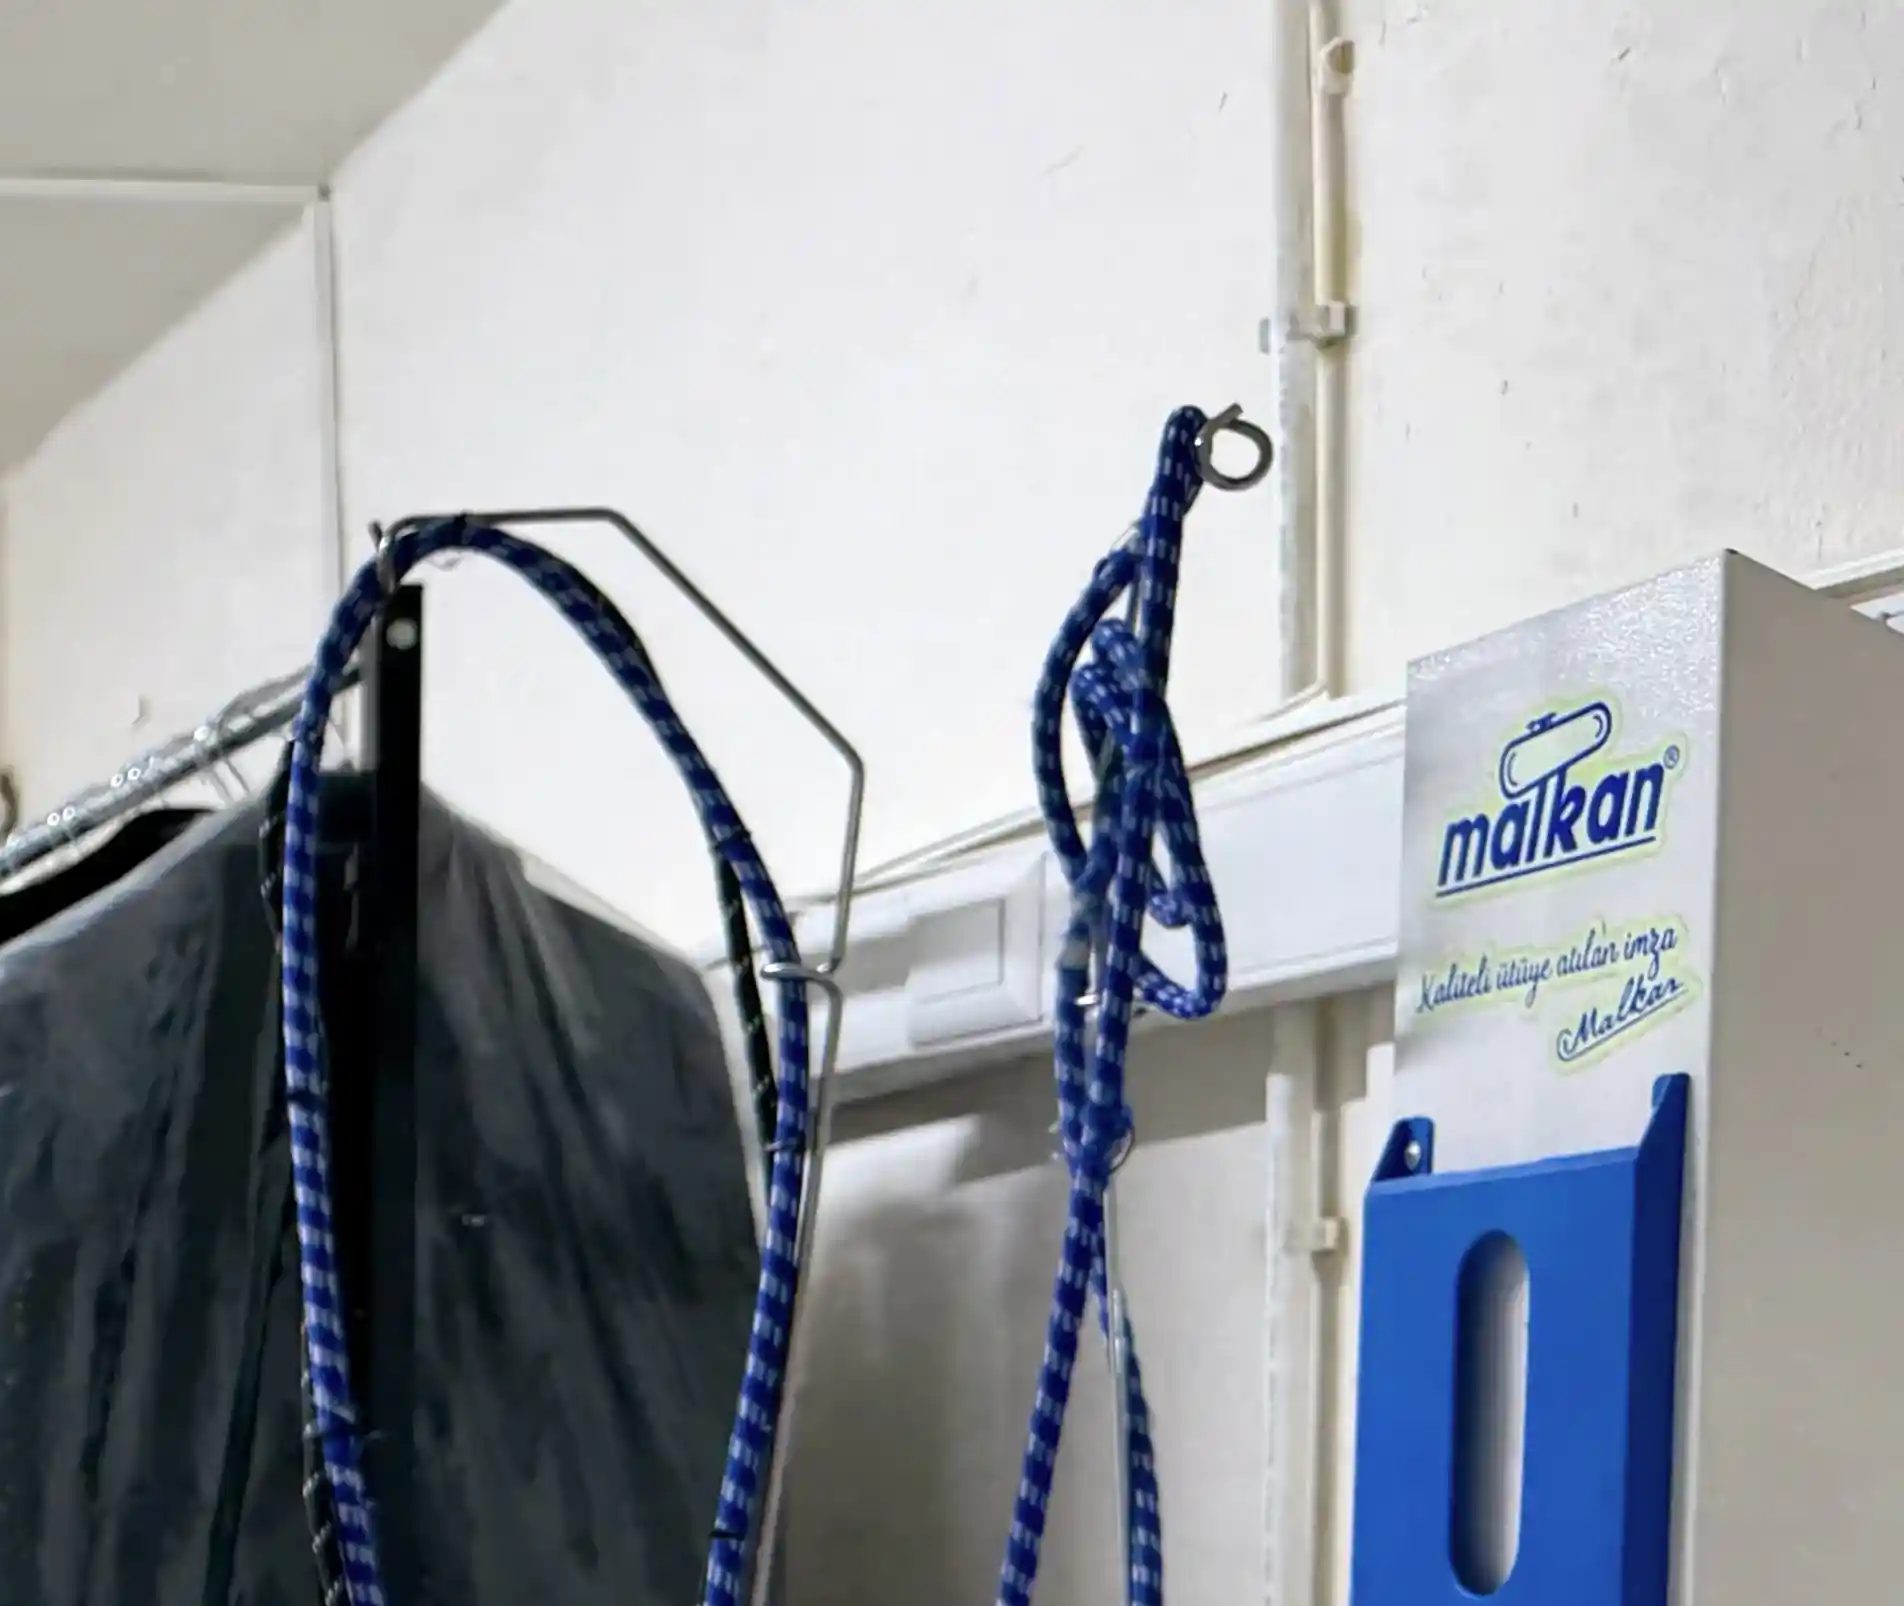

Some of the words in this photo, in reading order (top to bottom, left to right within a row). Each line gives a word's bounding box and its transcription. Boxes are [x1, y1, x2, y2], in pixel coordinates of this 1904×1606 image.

[1416, 952, 1491, 1013] Kaliteli
[1496, 956, 1553, 1009] ütüye
[1623, 927, 1678, 981] imza
[1556, 973, 1685, 1062] Malkan
